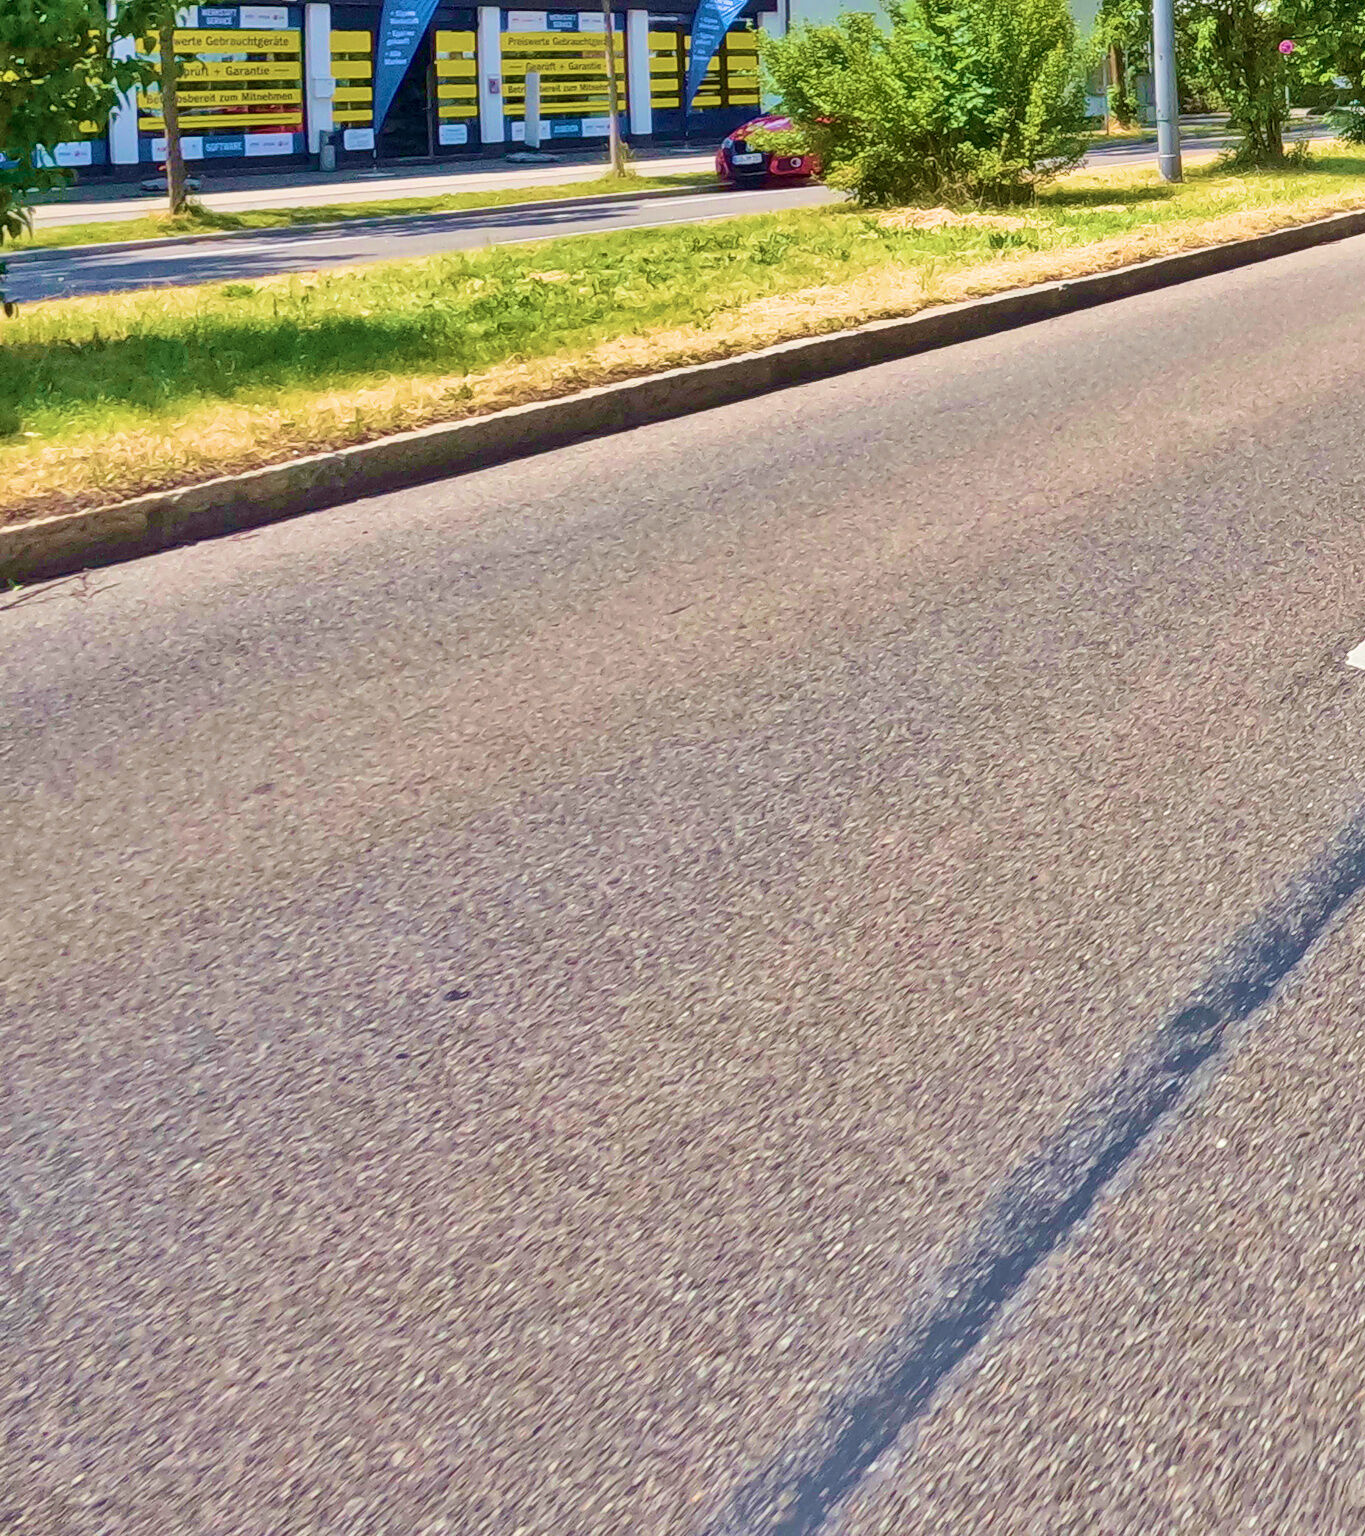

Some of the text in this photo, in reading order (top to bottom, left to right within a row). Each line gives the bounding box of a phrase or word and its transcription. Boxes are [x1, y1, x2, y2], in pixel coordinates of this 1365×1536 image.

[206, 36, 289, 48] Gebrauchtgeräte
[226, 65, 270, 76] Garantie
[219, 93, 238, 102] zum
[241, 89, 293, 102] Mitnehmen
